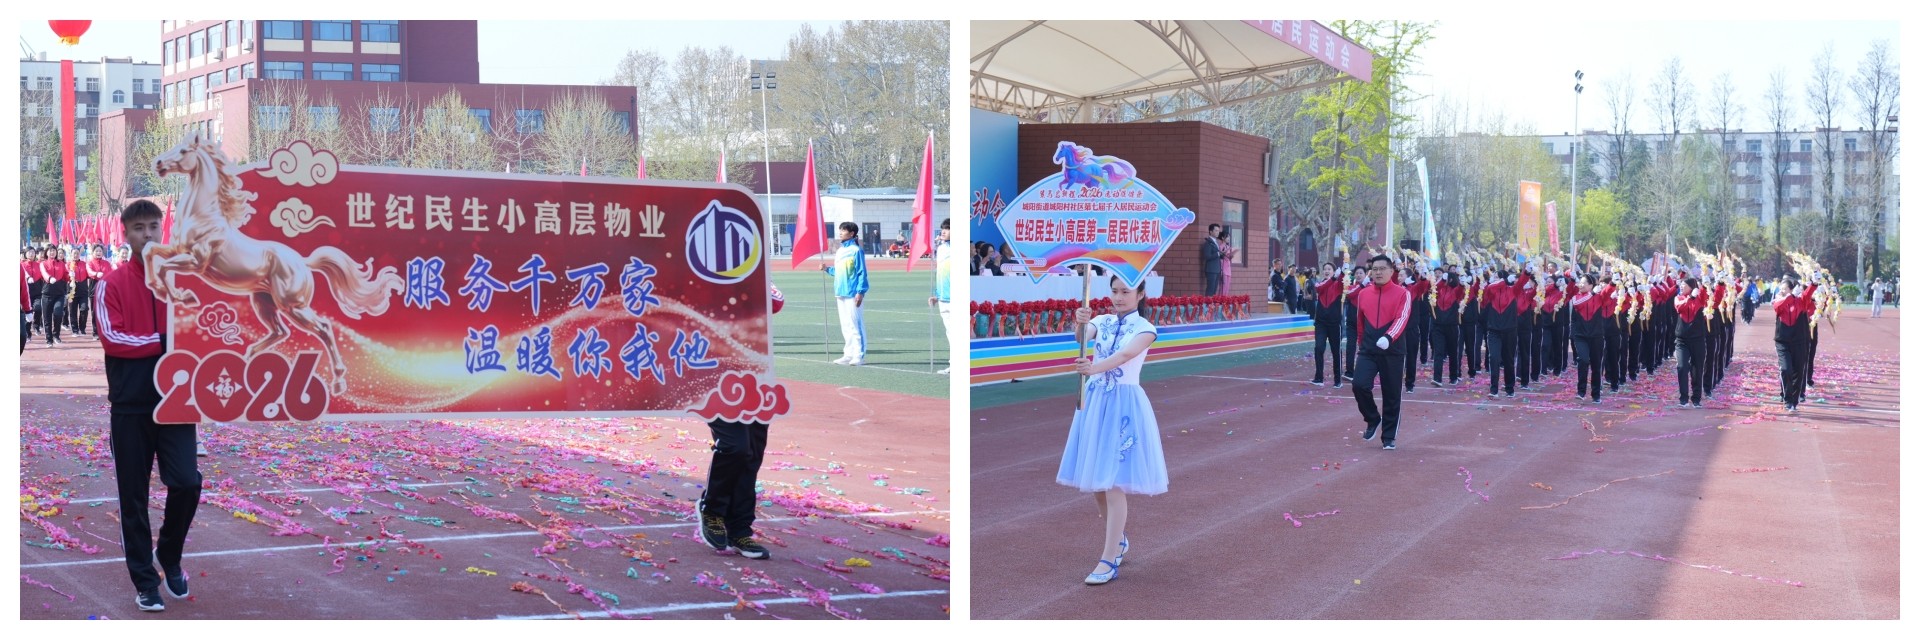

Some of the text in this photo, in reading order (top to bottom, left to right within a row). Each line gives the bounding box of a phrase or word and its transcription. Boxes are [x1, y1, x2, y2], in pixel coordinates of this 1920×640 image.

[1258, 20, 1350, 69] 居民运动会
[970, 187, 1006, 226] 动会
[1022, 202, 1157, 212] 城阳街道城阳村社区第七届千人居民运动会
[1078, 186, 1103, 199] 2026
[345, 192, 667, 238] 世纪民生小高层物业
[1015, 218, 1161, 244] 世纪民生小高层第一居民代表队
[404, 253, 661, 317] 服务千万家
[462, 323, 718, 385] 温暖你我他
[154, 351, 328, 424] 2026
[214, 376, 235, 398] 福
